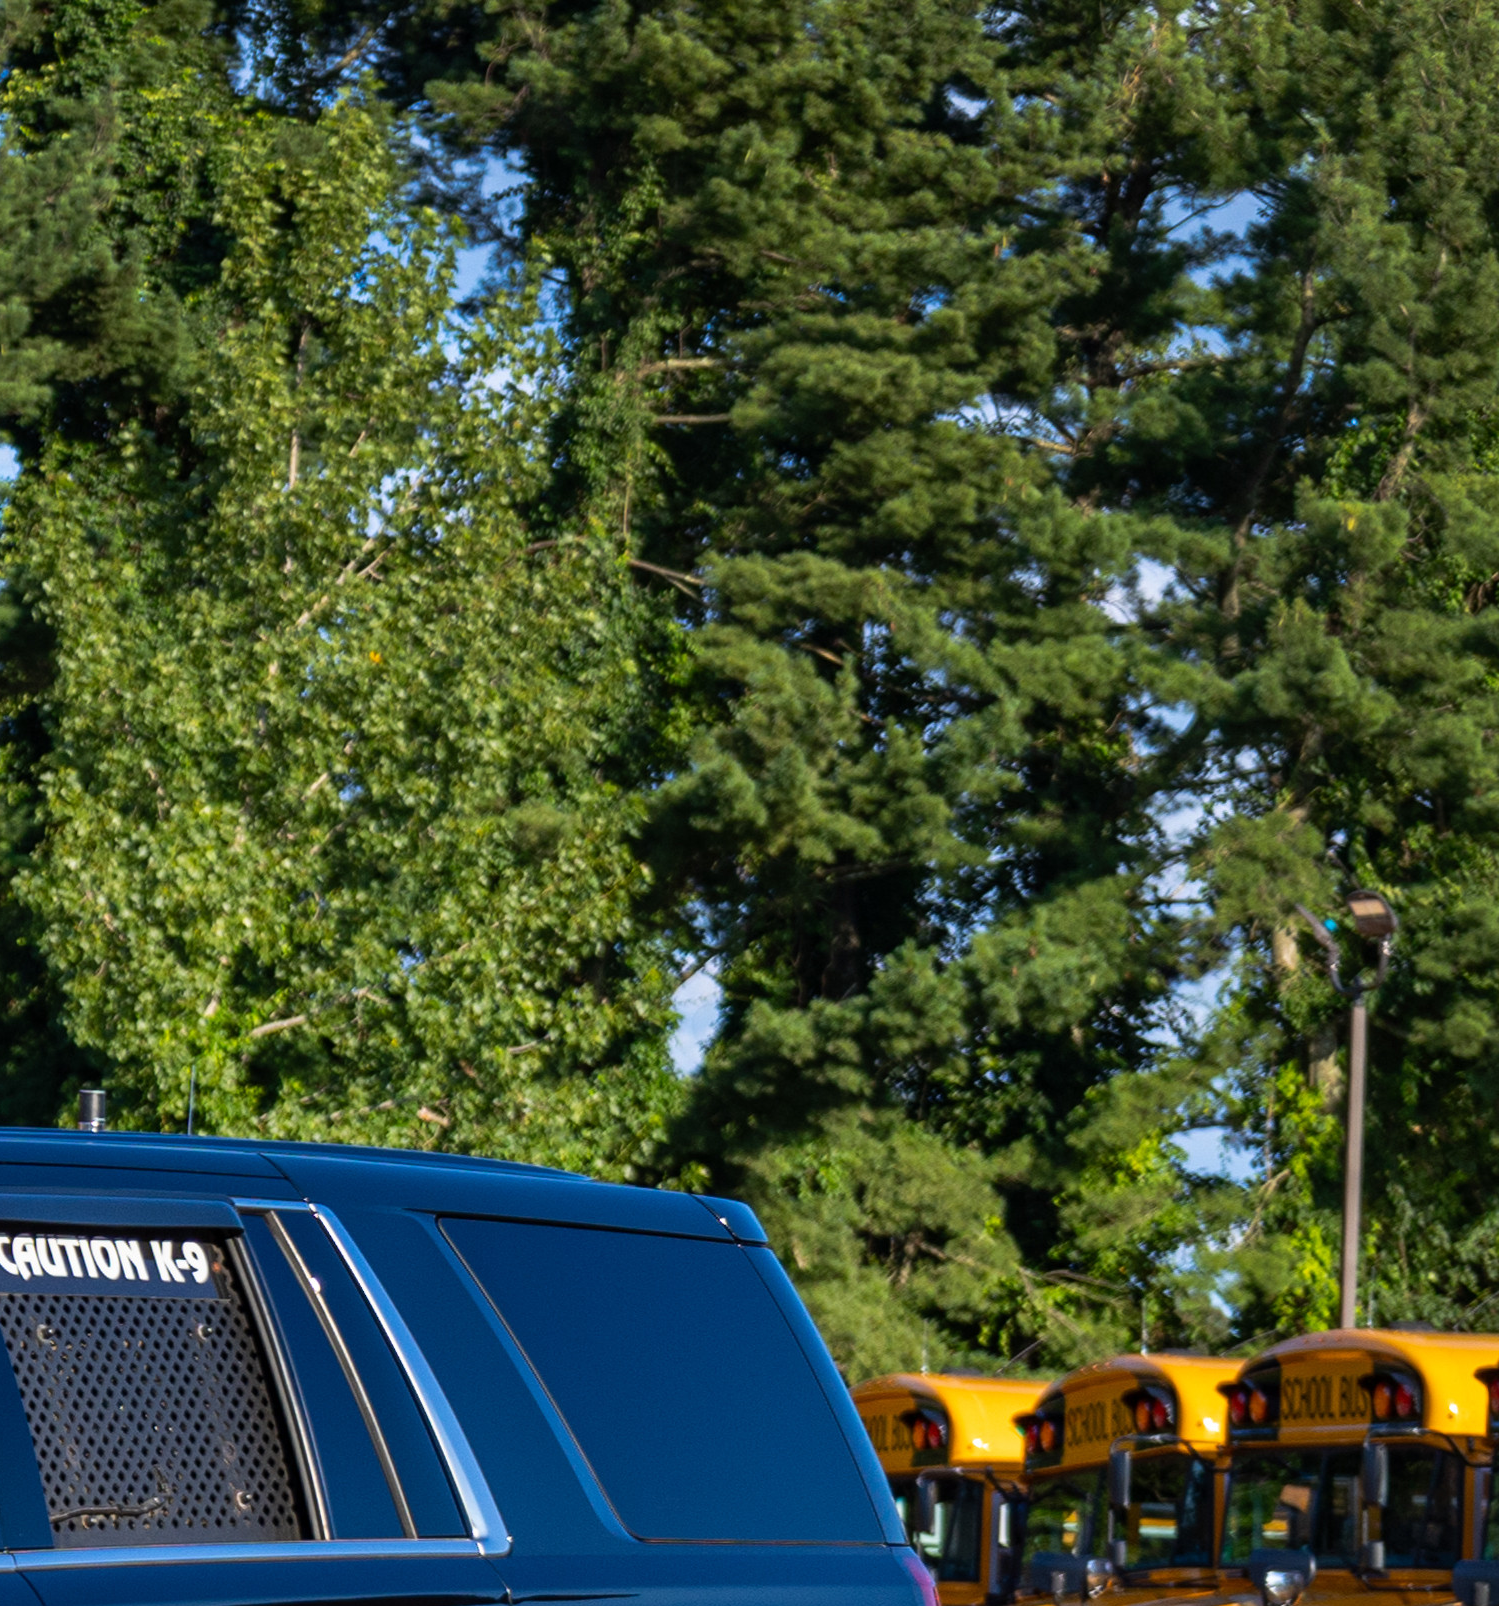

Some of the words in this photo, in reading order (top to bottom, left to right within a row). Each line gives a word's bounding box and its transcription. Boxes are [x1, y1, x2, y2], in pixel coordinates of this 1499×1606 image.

[149, 1238, 210, 1284] K-9
[1282, 1375, 1335, 1420] SCHOOL
[1340, 1374, 1369, 1418] BUS
[1066, 1400, 1108, 1447] SCHOOL
